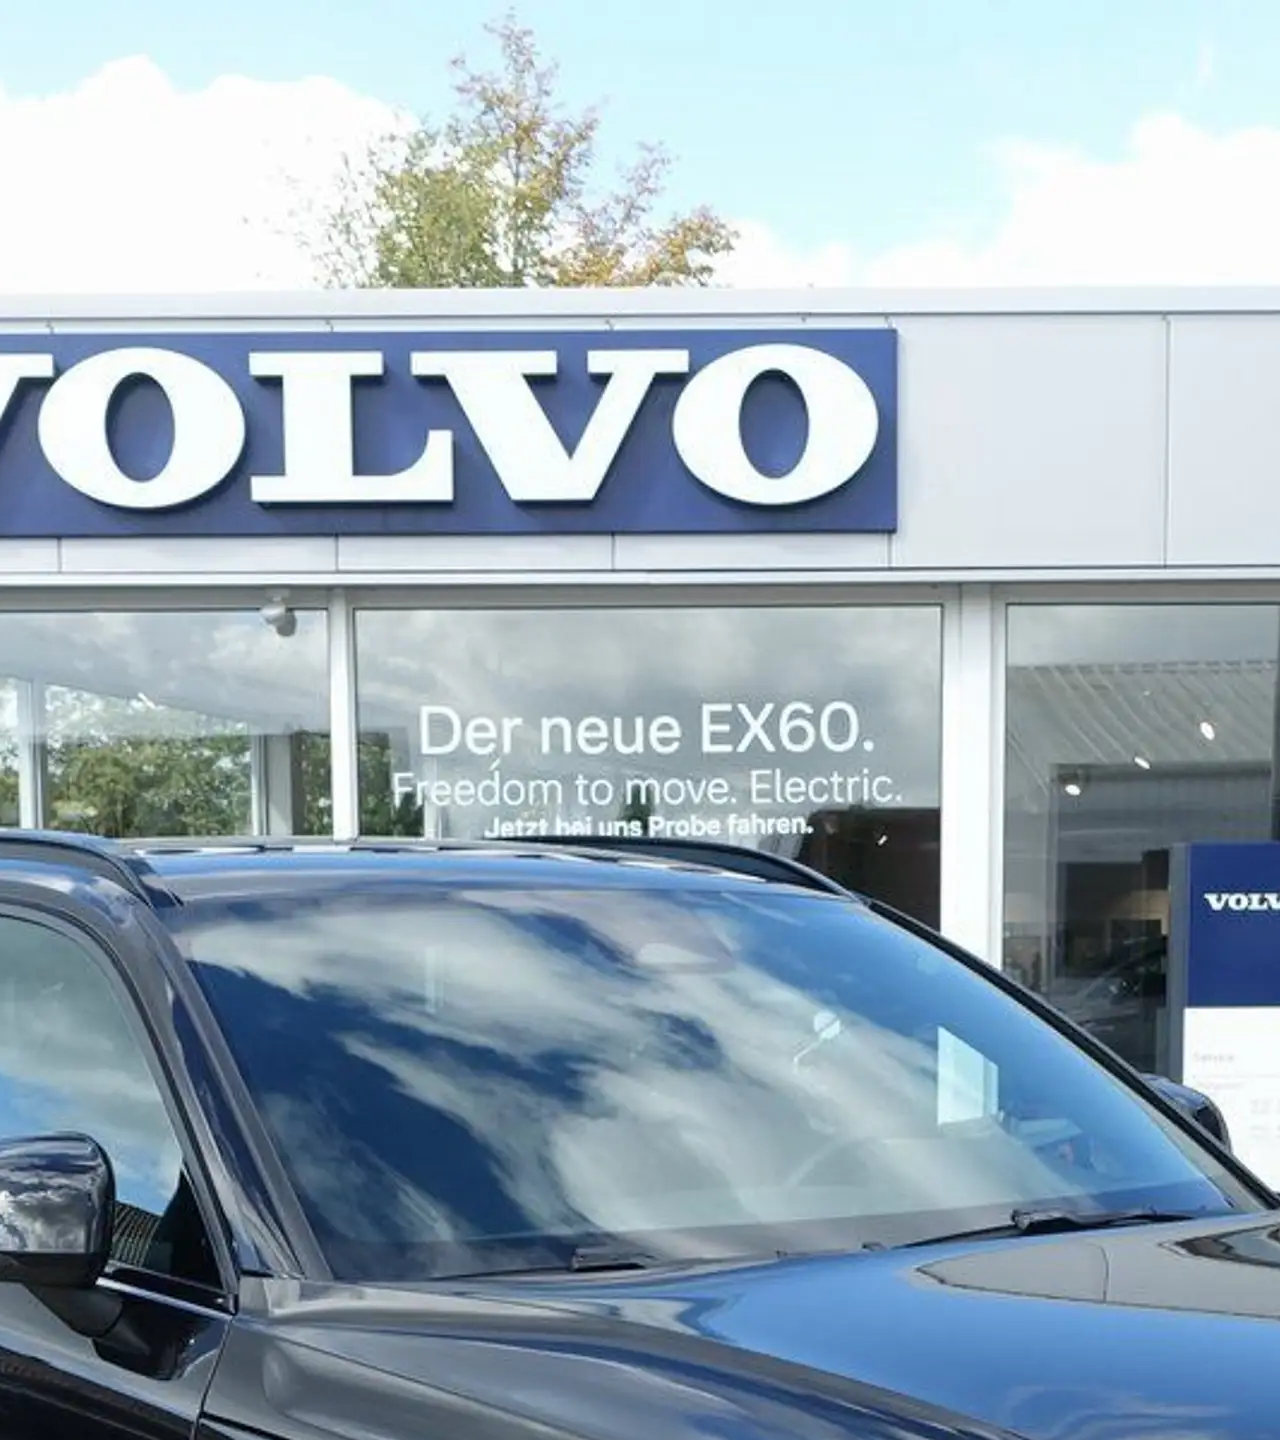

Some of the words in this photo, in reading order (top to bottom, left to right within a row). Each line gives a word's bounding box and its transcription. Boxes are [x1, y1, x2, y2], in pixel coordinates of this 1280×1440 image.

[419, 705, 522, 755] Der
[540, 714, 682, 754] neue
[701, 701, 876, 753] EX60.
[391, 765, 563, 806] Freedom
[576, 773, 613, 805] to
[625, 775, 738, 805] move.
[749, 767, 904, 804] Electric.
[483, 814, 550, 838] Jetzt
[555, 814, 592, 837] bei
[599, 819, 644, 837] uns
[647, 815, 721, 837] Probe
[727, 813, 814, 836] fahren.
